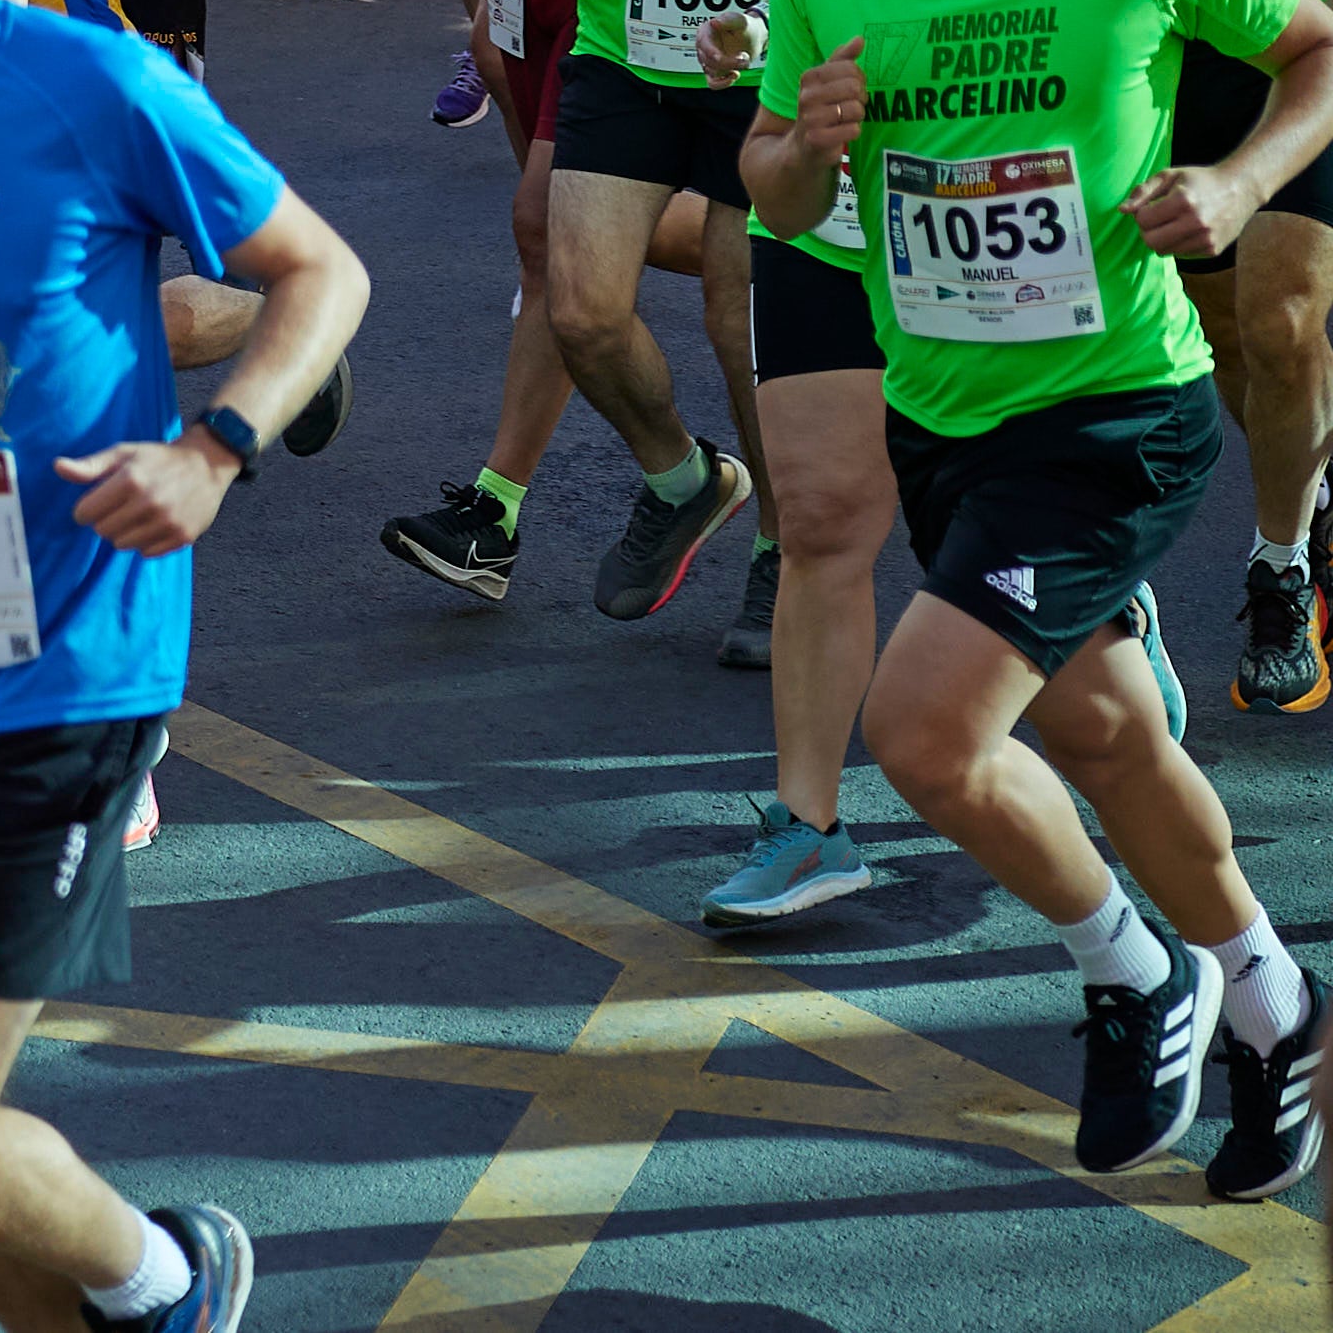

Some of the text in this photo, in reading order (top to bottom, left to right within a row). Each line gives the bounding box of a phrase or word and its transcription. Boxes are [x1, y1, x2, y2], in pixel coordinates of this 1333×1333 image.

[927, 6, 1060, 44] MEMORIAL
[930, 36, 1052, 81] PADRE
[864, 74, 1067, 123] MARCELINO
[934, 163, 951, 186] 17
[953, 171, 991, 186] PADRE
[1020, 157, 1067, 171] OXIMESA
[934, 181, 998, 197] MARCELINO
[890, 219, 909, 259] CAJÓN
[912, 196, 1068, 263] 1053
[961, 266, 1020, 283] MANUEL
[985, 573, 1039, 613] adidas
[53, 821, 88, 900] adidas
